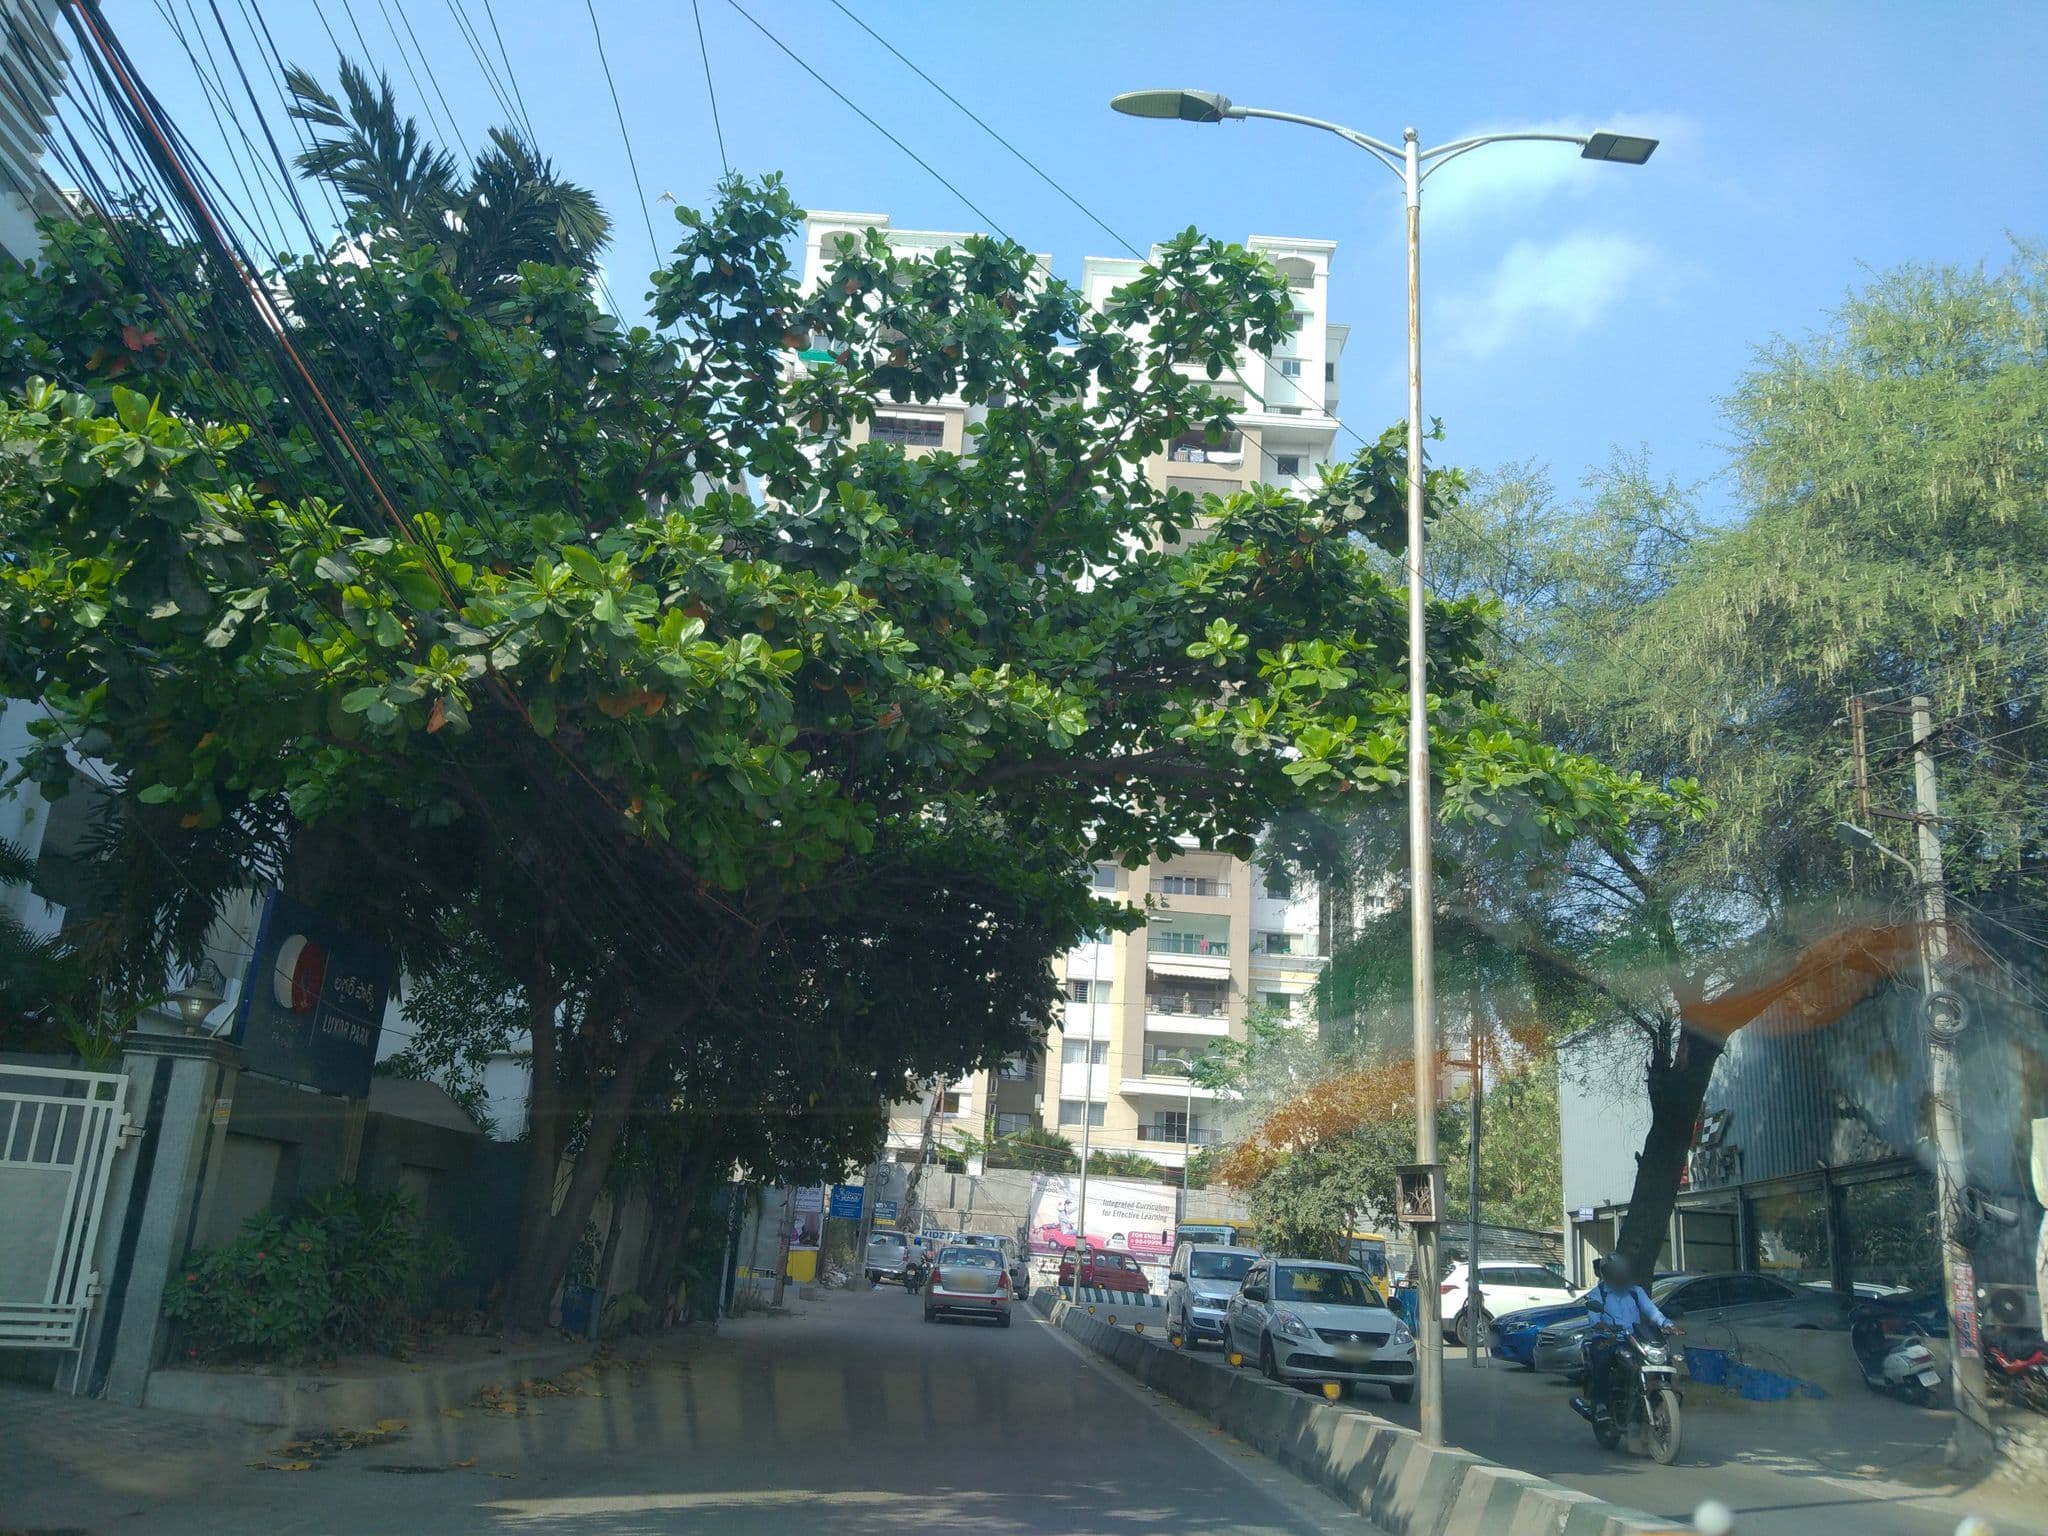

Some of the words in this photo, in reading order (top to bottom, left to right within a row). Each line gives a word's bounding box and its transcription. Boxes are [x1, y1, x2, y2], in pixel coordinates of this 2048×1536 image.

[322, 1013, 350, 1040] LUXOR
[349, 1024, 370, 1047] PARK
[1102, 1199, 1135, 1209] Integrated
[1136, 1201, 1170, 1212] Curriculum
[1102, 1209, 1111, 1217] for
[1112, 1209, 1140, 1219] Effective
[1141, 1211, 1168, 1223] Learning
[922, 1230, 945, 1239] KIDZ
